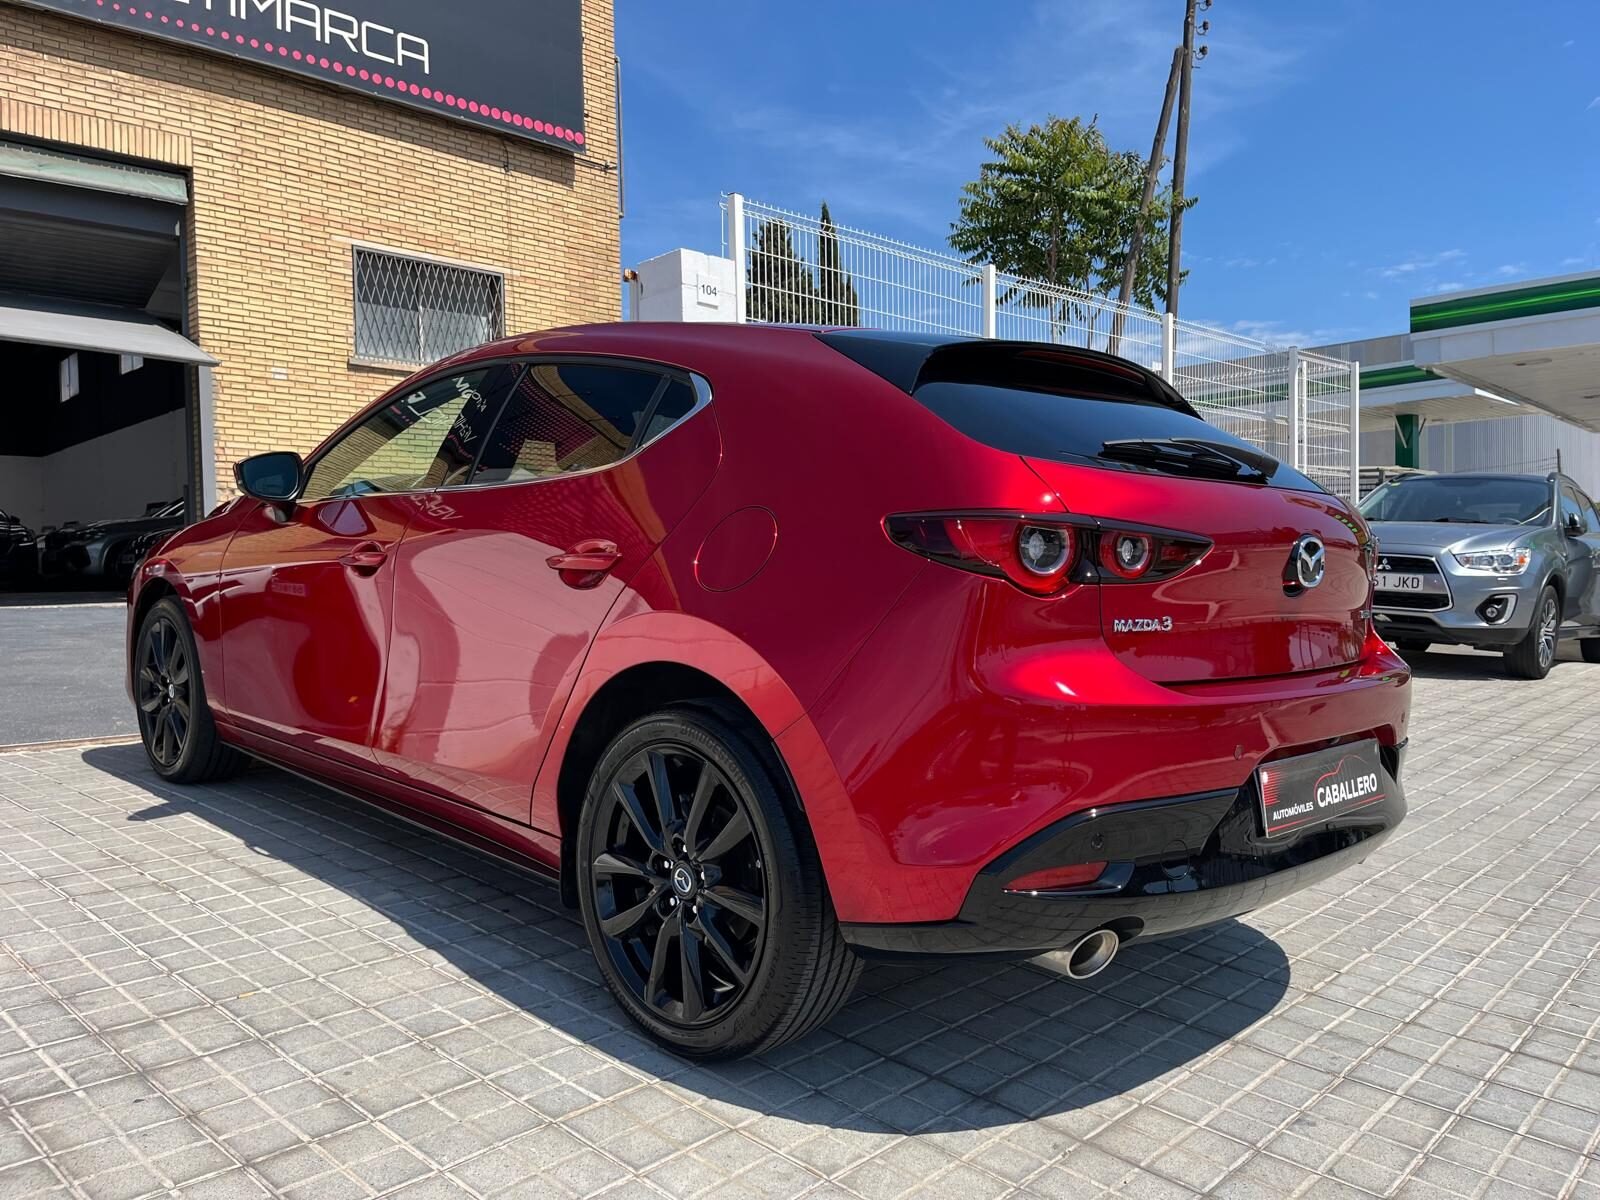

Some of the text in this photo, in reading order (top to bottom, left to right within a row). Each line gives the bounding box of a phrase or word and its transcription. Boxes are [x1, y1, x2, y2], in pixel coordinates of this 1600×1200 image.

[701, 284, 717, 297] 104
[1393, 576, 1420, 589] JKD
[1114, 616, 1173, 632] MAZDA3
[1273, 773, 1377, 821] AUTOMÓVILES CABALLERO
